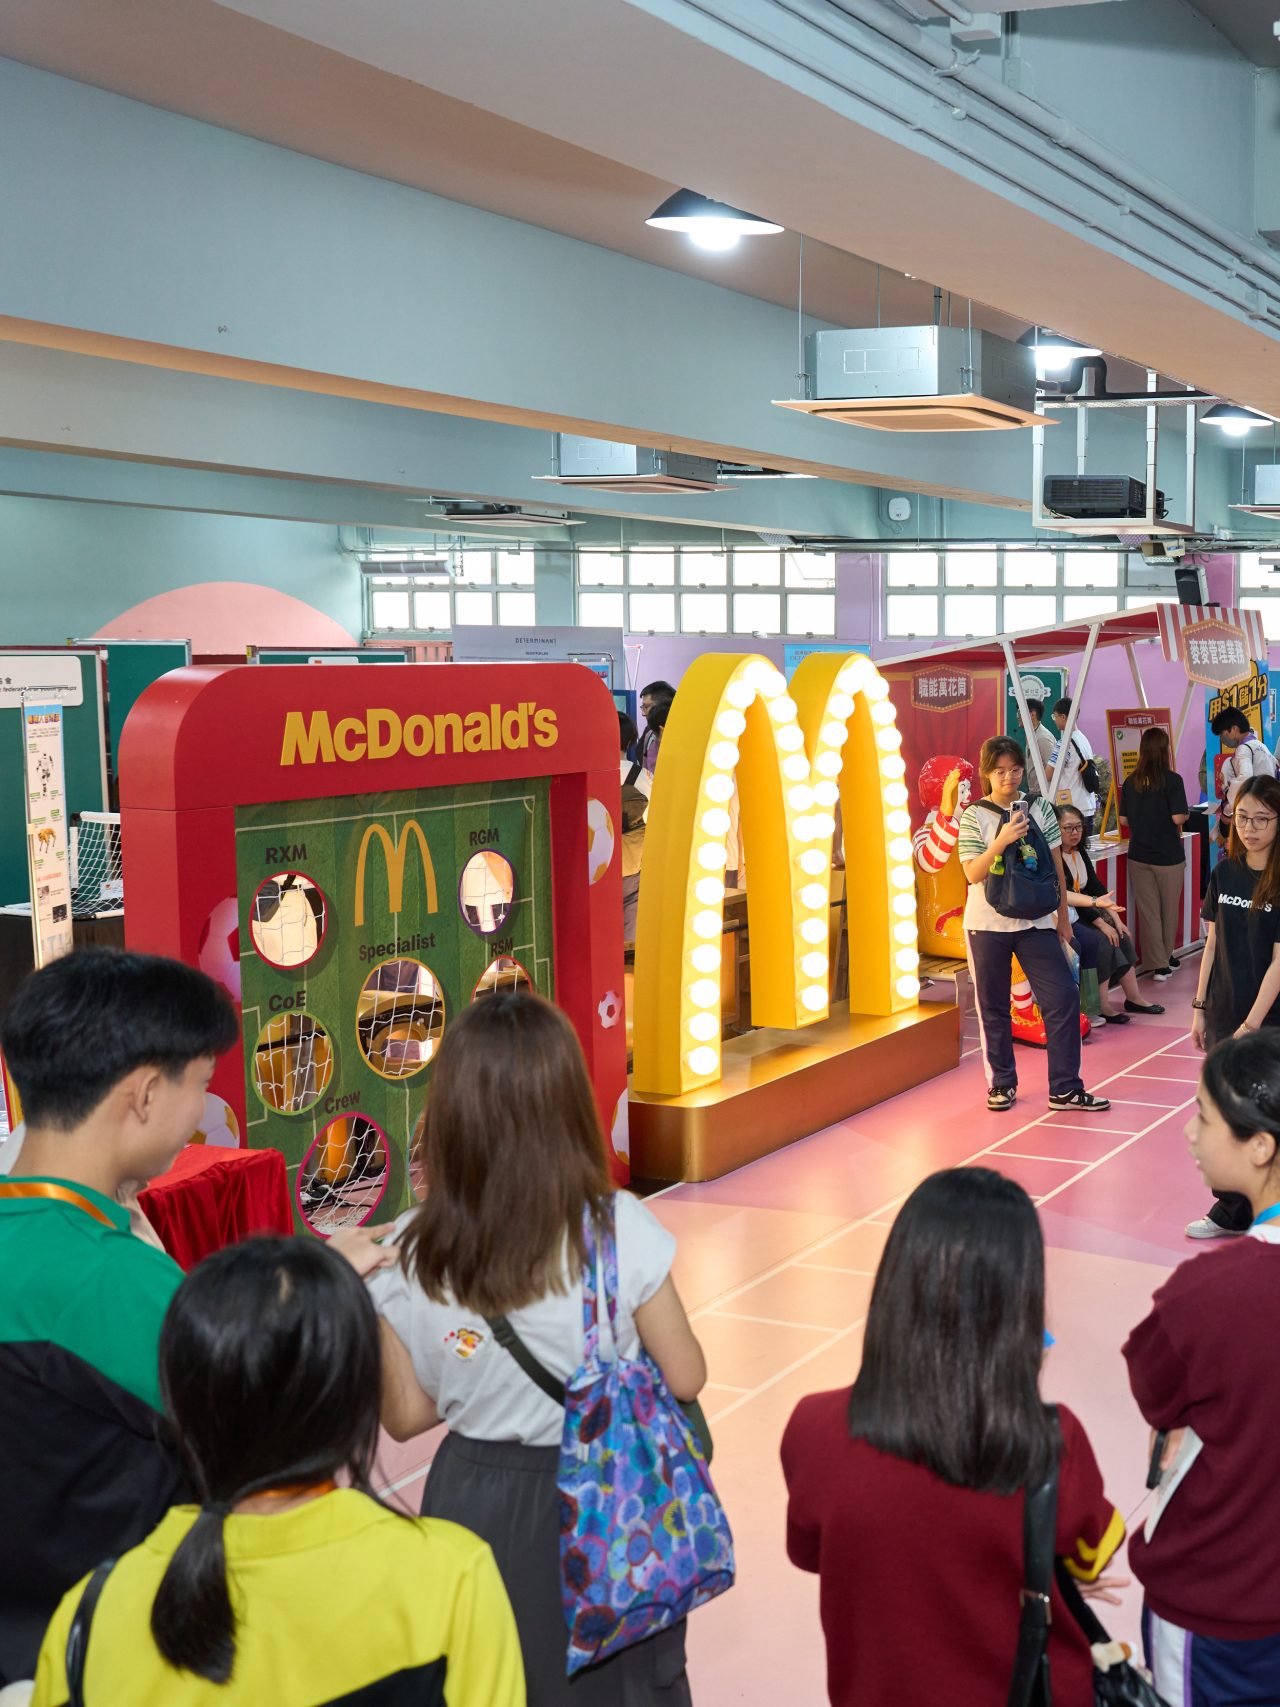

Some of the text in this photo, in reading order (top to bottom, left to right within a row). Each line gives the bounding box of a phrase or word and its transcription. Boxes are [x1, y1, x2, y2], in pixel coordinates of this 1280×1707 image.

[1189, 638, 1245, 665] 麥麥管理業務
[918, 677, 967, 699] 職能萬花筒
[280, 702, 559, 766] McDonald's
[469, 828, 500, 846] RGM
[265, 844, 308, 865] RXM
[1218, 893, 1273, 913] McDon's
[358, 932, 437, 963] Specialist
[490, 938, 513, 958] RSM
[268, 990, 307, 1012] CoE
[324, 1090, 361, 1114] Crew
